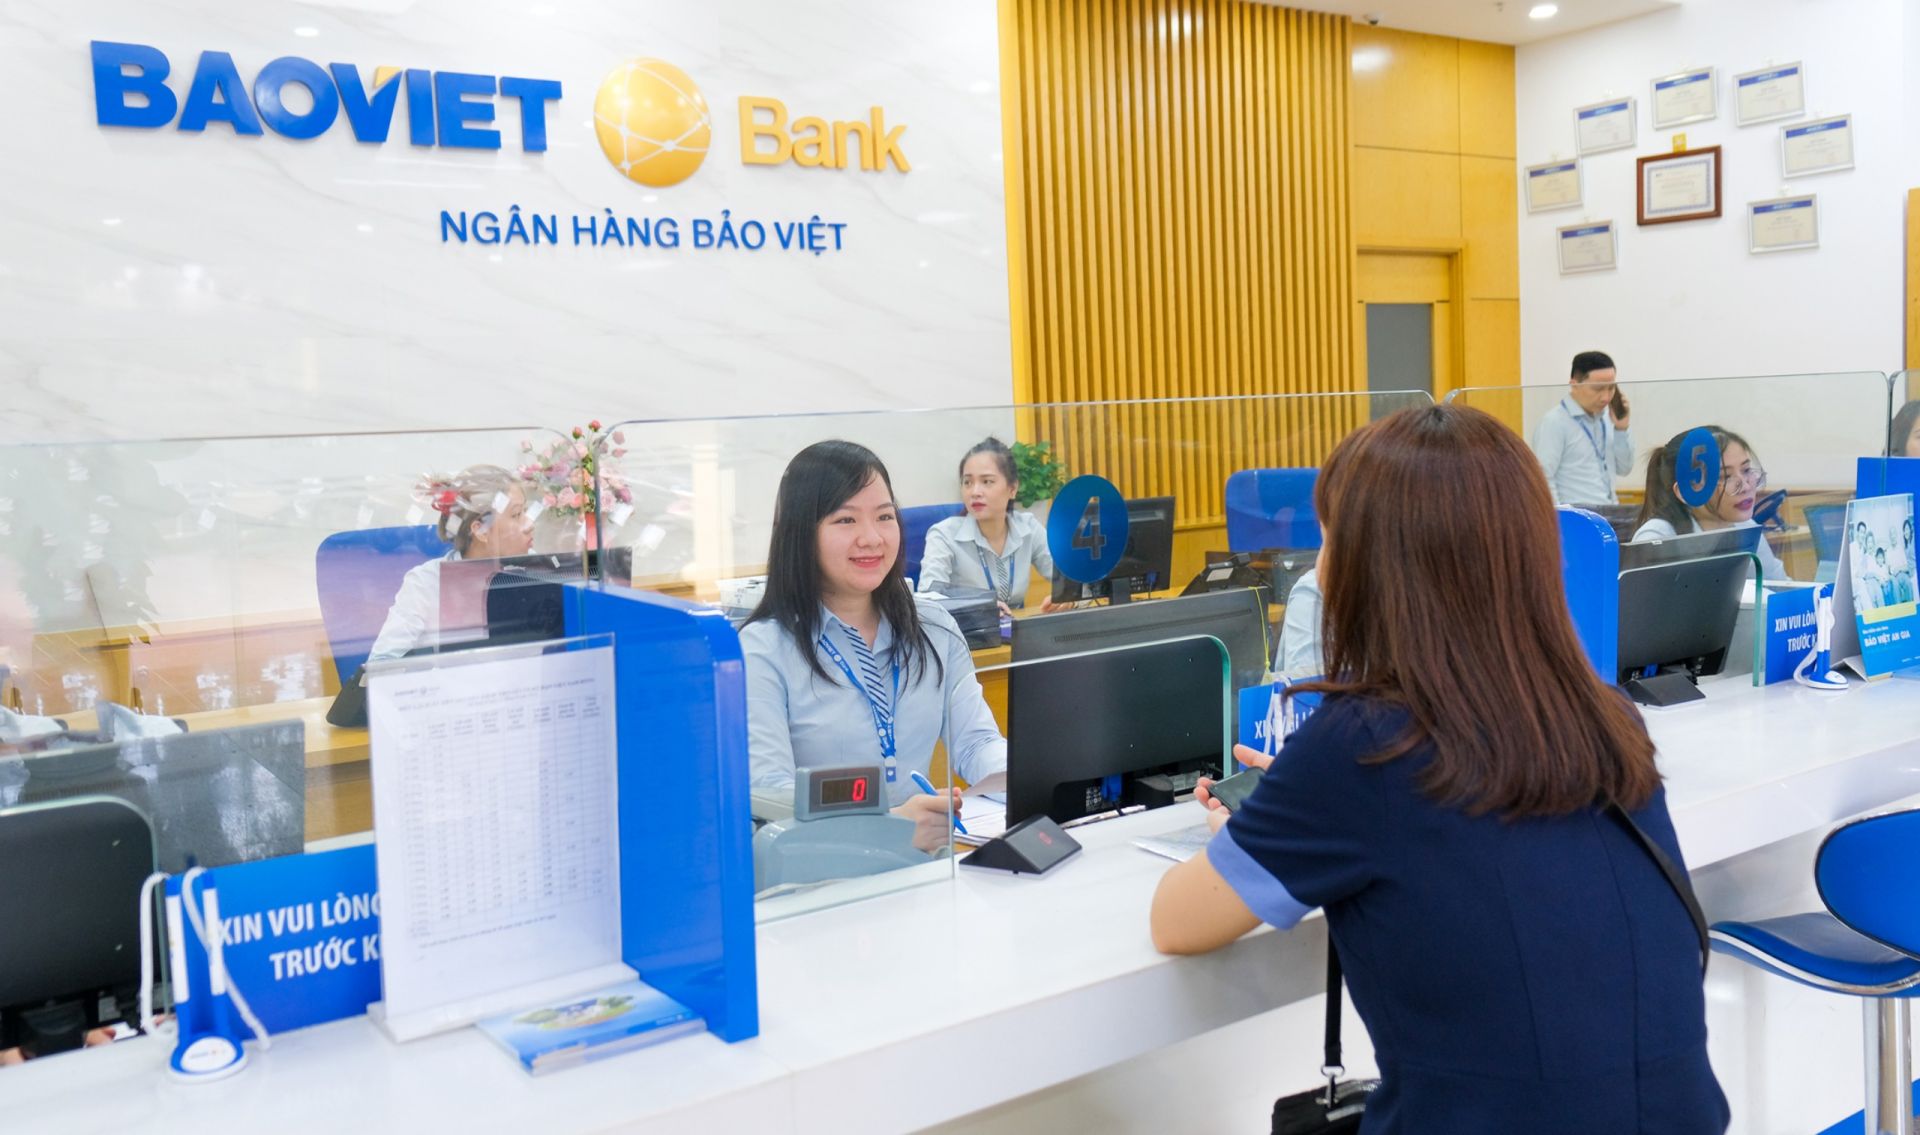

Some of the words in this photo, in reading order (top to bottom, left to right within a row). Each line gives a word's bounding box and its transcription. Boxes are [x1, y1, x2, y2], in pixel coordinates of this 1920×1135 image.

[91, 40, 562, 152] BAOVIET
[738, 96, 912, 173] Bank
[440, 204, 558, 245] NGÂN
[572, 207, 680, 248] HÀNG
[692, 209, 766, 250] BẢO
[773, 214, 848, 256] VIỆT
[1690, 444, 1707, 492] 5
[1071, 495, 1107, 560] 4
[1774, 617, 1788, 633] XIN
[1788, 614, 1801, 630] VUI
[1802, 610, 1817, 628] LÒN
[852, 778, 866, 801] 0
[219, 911, 263, 946] XIN
[267, 902, 315, 937] VUI
[269, 936, 358, 981] TRƯỚC
